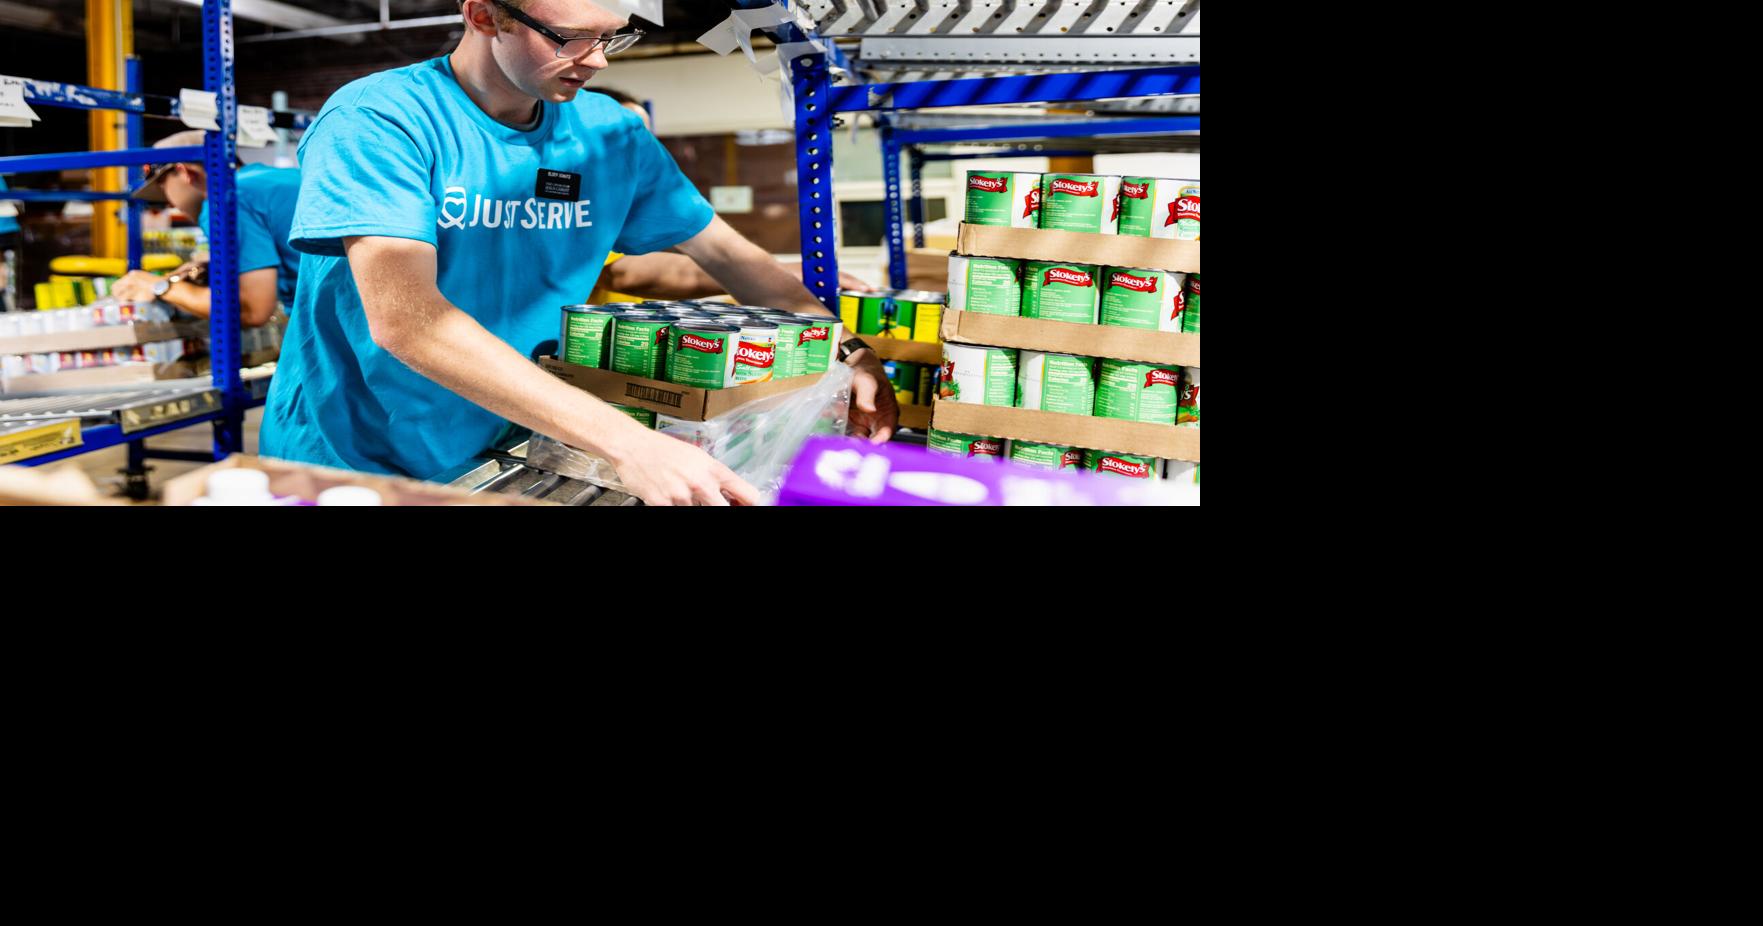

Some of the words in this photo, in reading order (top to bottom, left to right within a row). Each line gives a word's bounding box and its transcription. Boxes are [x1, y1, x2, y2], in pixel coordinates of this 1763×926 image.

[1053, 179, 1095, 193] Stokely's
[469, 194, 521, 229] JUST
[520, 198, 592, 230] SERVE
[1049, 269, 1091, 283] Stokely's
[1111, 272, 1153, 288] Stokely's
[682, 335, 720, 350] Stokely's
[736, 345, 775, 363] okely's
[1102, 457, 1146, 475] Stokely's
